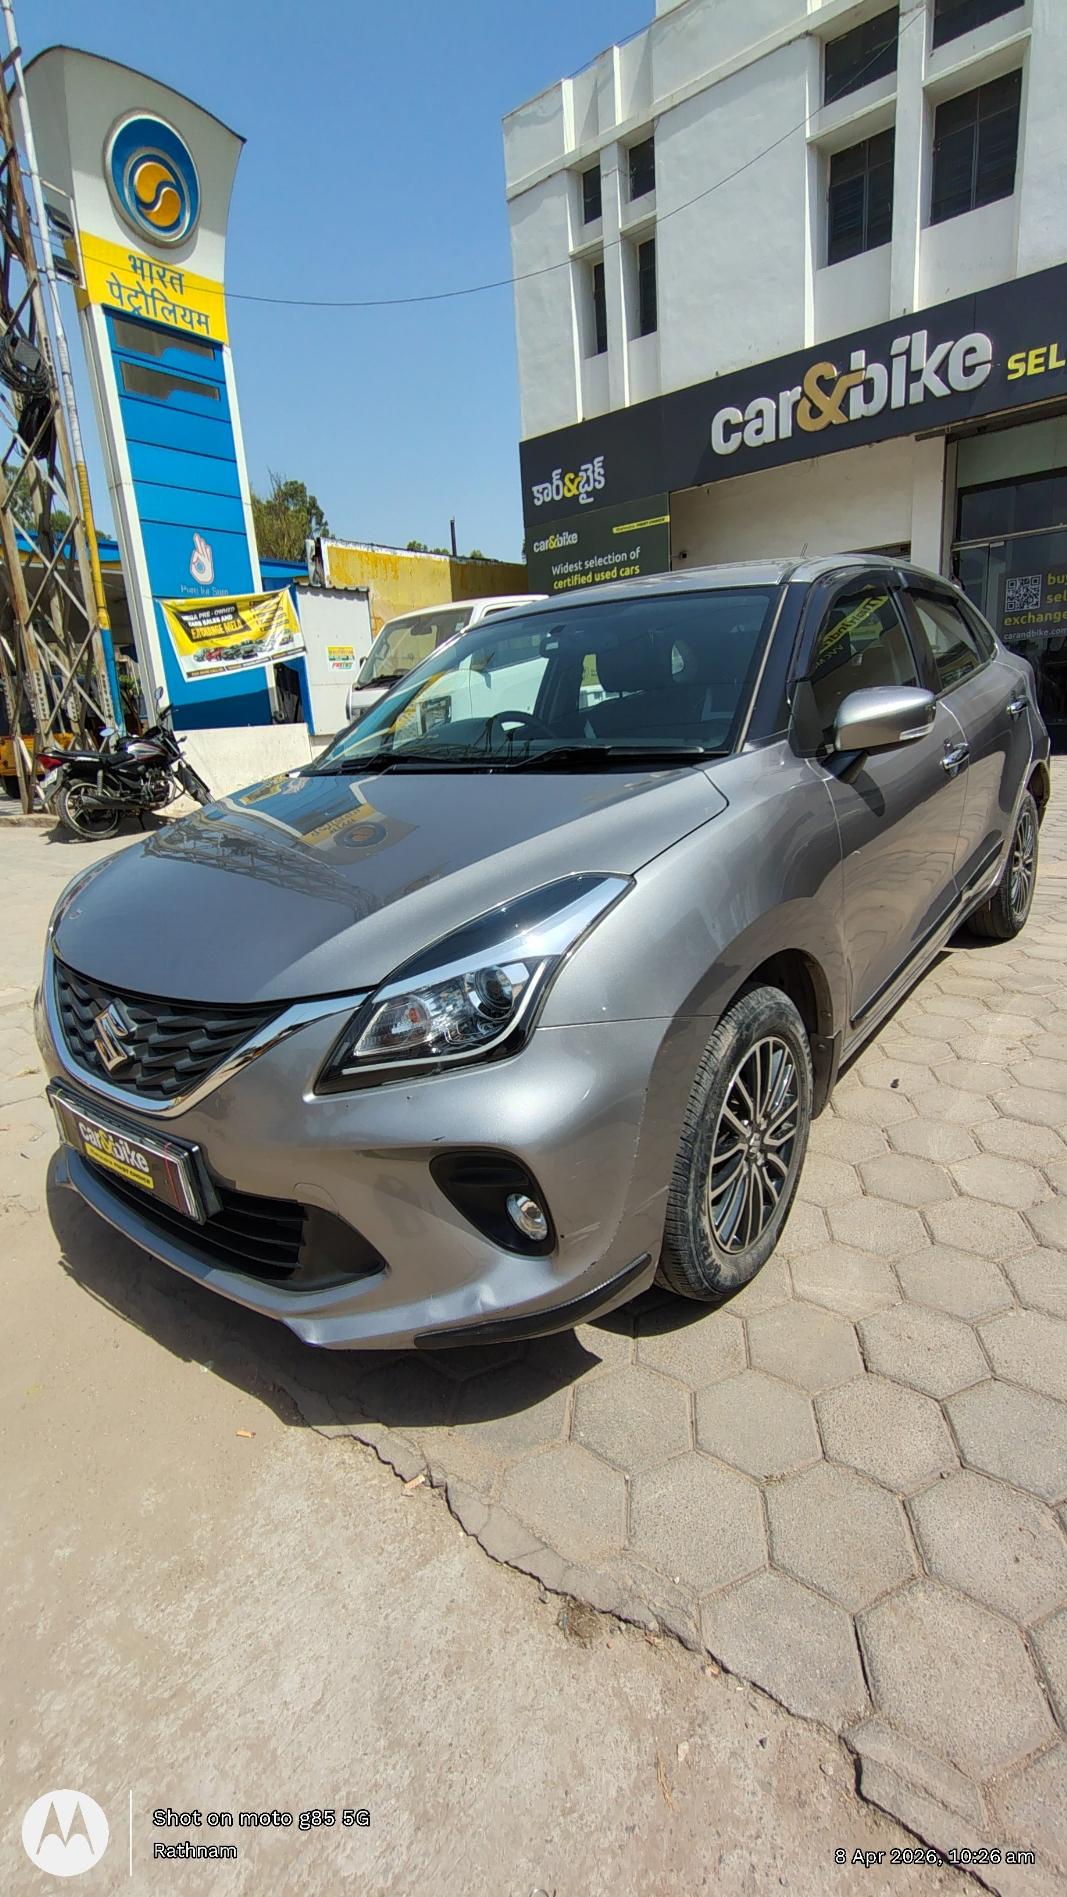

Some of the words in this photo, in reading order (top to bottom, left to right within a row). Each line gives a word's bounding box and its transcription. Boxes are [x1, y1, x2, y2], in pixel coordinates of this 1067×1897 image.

[128, 254, 184, 295] भारत
[106, 272, 210, 335] पेट्रोलियम
[711, 329, 993, 456] car&bike
[533, 530, 579, 553] car&bike
[551, 561, 583, 576] Widest
[584, 550, 628, 570] selection
[629, 546, 641, 560] of
[553, 570, 593, 590] certified
[594, 568, 618, 581] used
[619, 564, 640, 577] cars
[78, 1121, 150, 1174] car&bike
